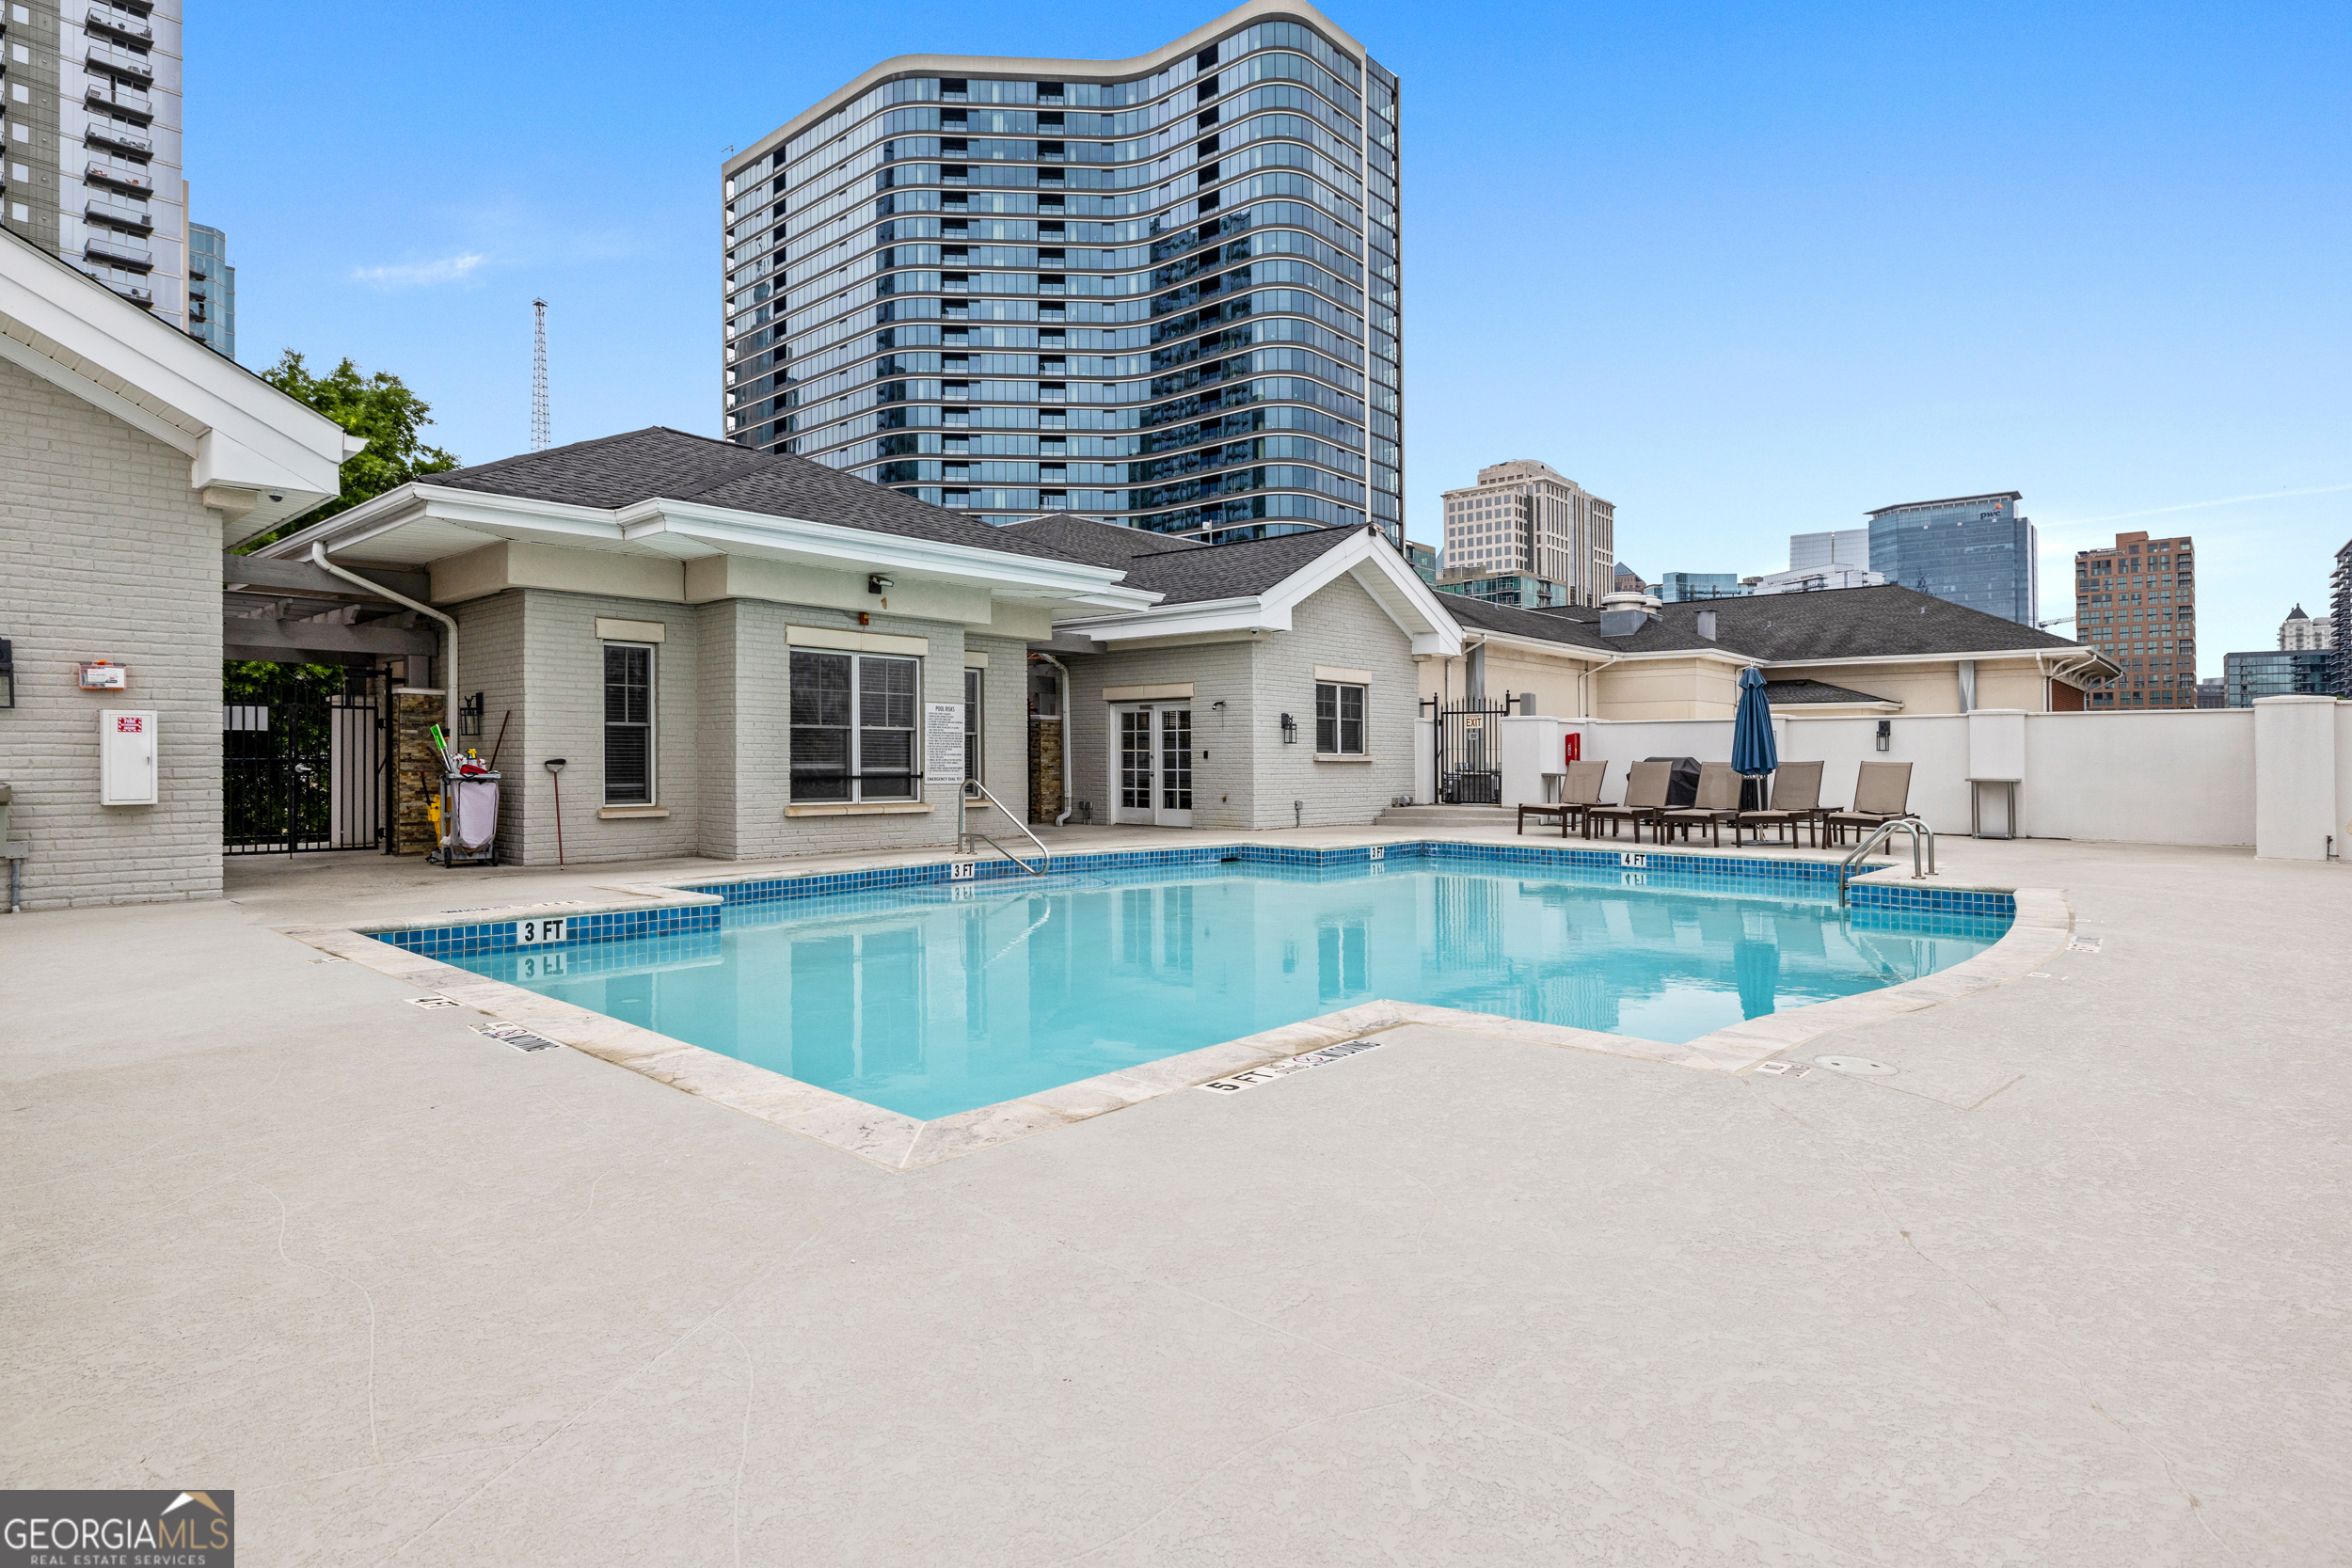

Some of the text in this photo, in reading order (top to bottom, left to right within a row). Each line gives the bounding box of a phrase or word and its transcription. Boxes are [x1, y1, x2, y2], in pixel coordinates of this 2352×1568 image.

[1980, 510, 2001, 520] pwc
[1466, 718, 1482, 727] EXIT
[1372, 847, 1384, 858] 3 FT
[1625, 853, 1645, 865] 4 FT
[954, 863, 974, 878] 3 FT
[524, 919, 564, 942] 3 FT
[1206, 1070, 1274, 1091] 5 FT
